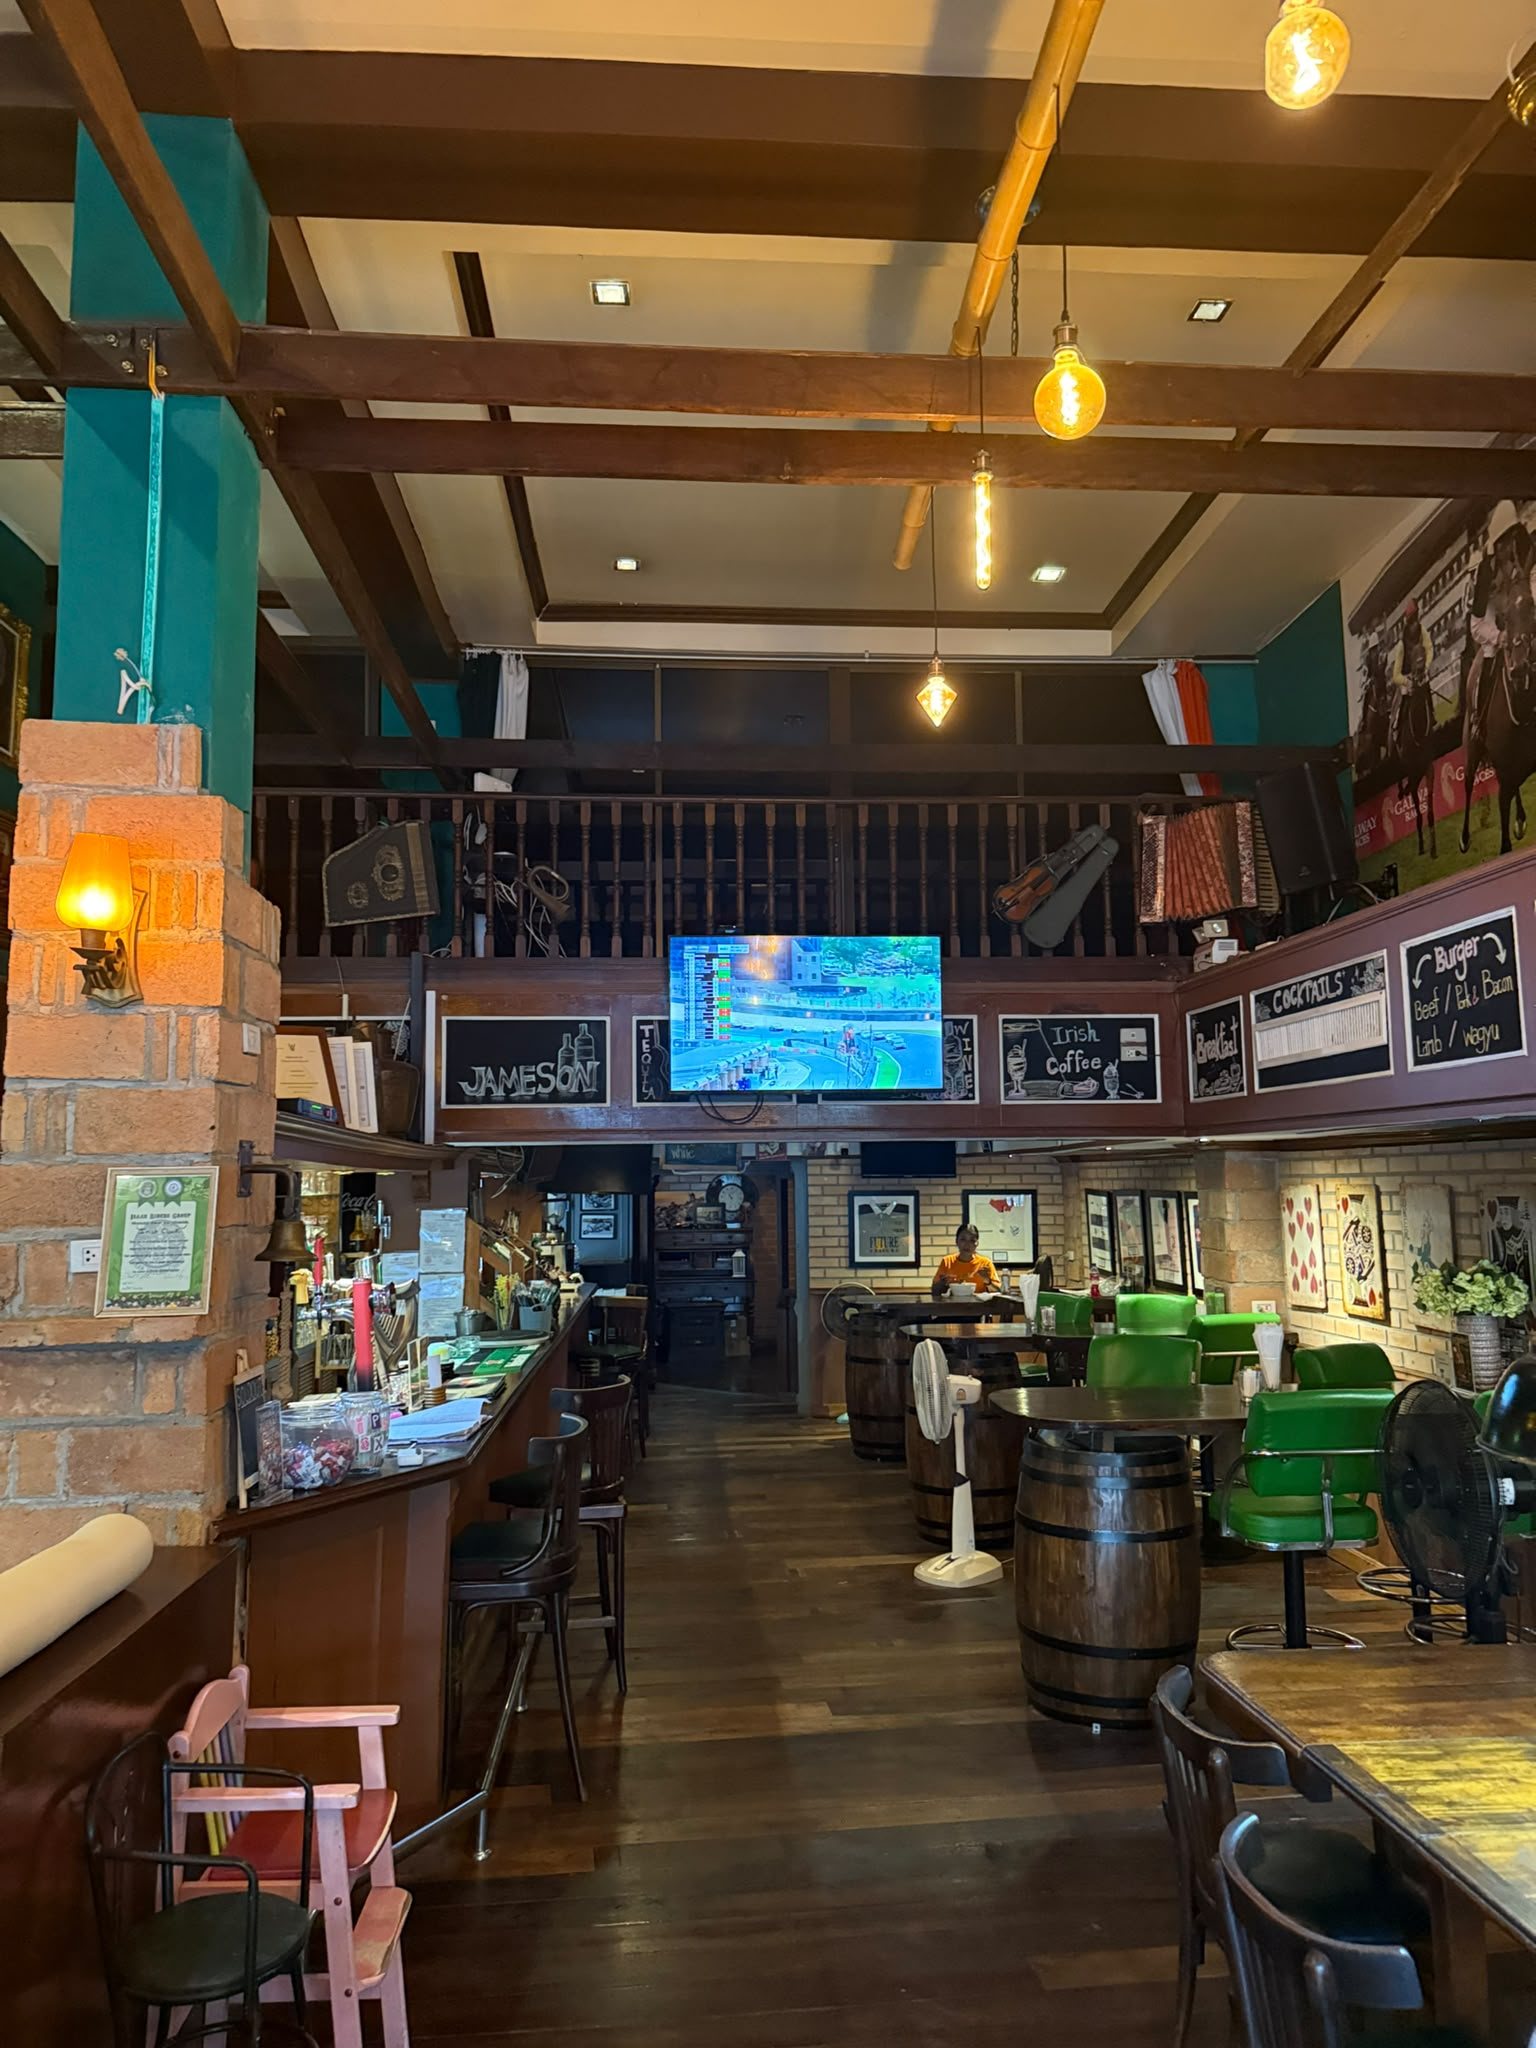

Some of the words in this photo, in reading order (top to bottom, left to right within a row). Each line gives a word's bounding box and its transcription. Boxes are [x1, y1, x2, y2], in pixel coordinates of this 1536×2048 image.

[1433, 936, 1480, 981] Burger
[1414, 986, 1440, 1021] Beef
[1481, 969, 1513, 1000] Bacon
[1050, 1021, 1100, 1045] Irish
[1196, 1015, 1238, 1064] Breakfast
[1416, 1024, 1442, 1057] Lamb
[457, 1061, 600, 1097] JAMESON
[640, 1025, 656, 1100] TEQUILA
[1046, 1049, 1102, 1075] Coffee
